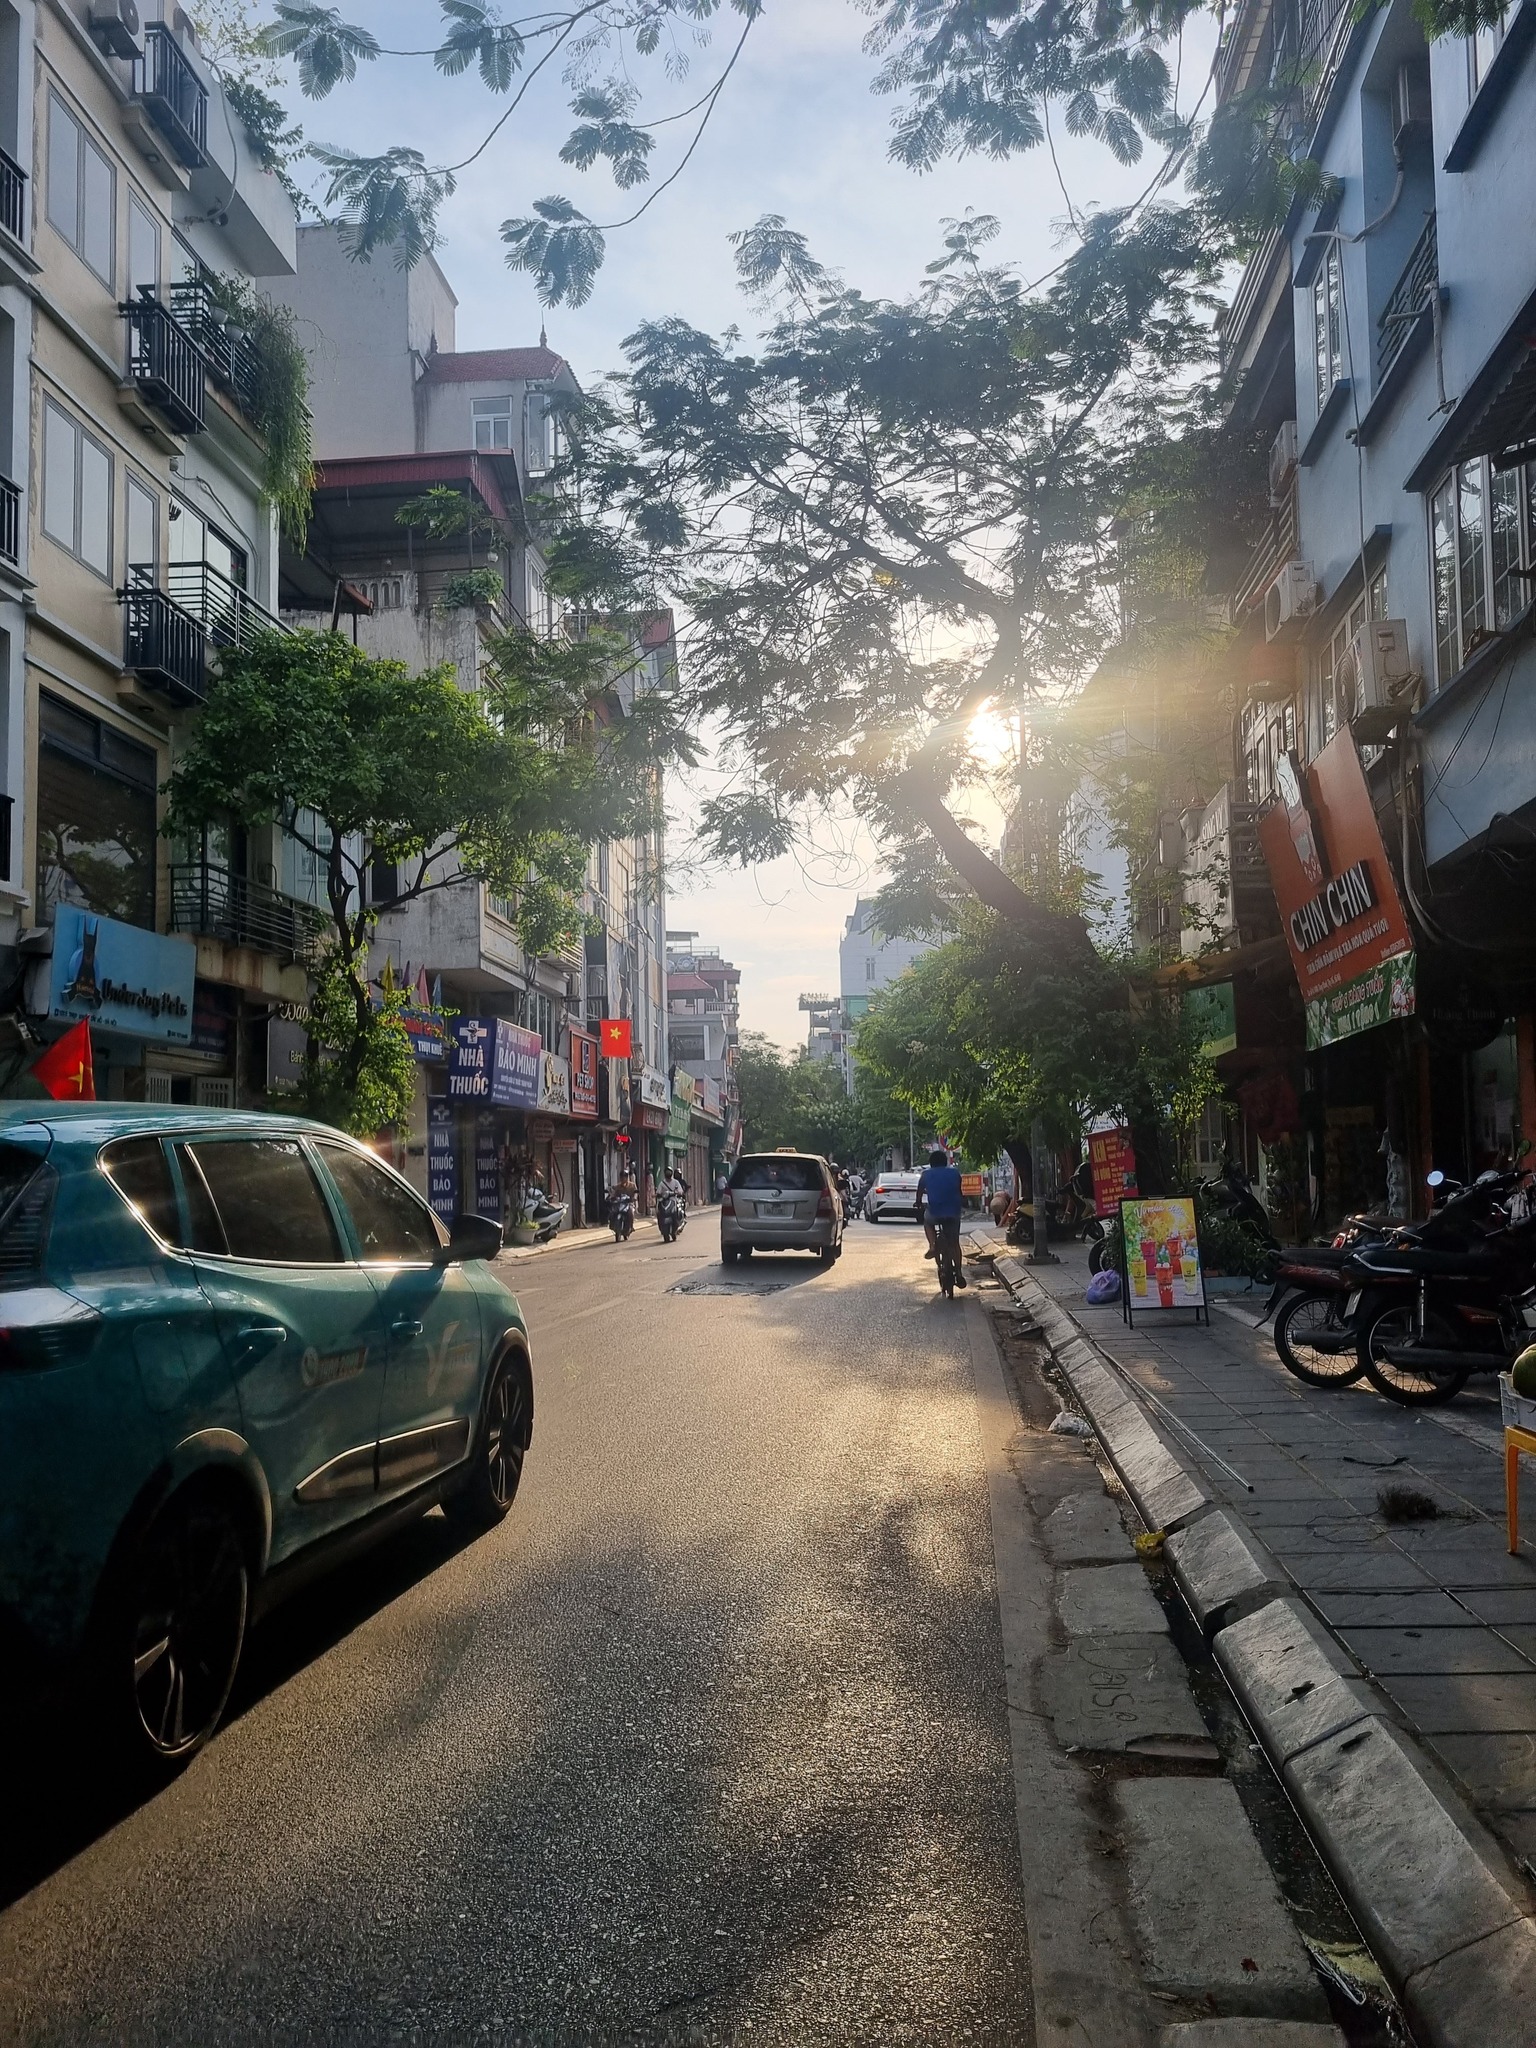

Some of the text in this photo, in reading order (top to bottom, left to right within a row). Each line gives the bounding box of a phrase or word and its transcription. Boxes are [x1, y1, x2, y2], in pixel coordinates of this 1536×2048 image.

[1290, 861, 1372, 953] CHIN CHIN
[459, 1045, 484, 1067] NHÀ
[498, 1042, 537, 1077] BẢO MINH
[450, 1071, 489, 1095] THUỐC
[434, 1130, 449, 1147] NHÀ
[430, 1151, 454, 1170] THUỐC
[477, 1154, 498, 1171] THUỐC
[433, 1174, 451, 1191] BẢO
[480, 1174, 496, 1190] BẢO
[431, 1198, 454, 1211] MINH
[478, 1196, 498, 1208] MINH
